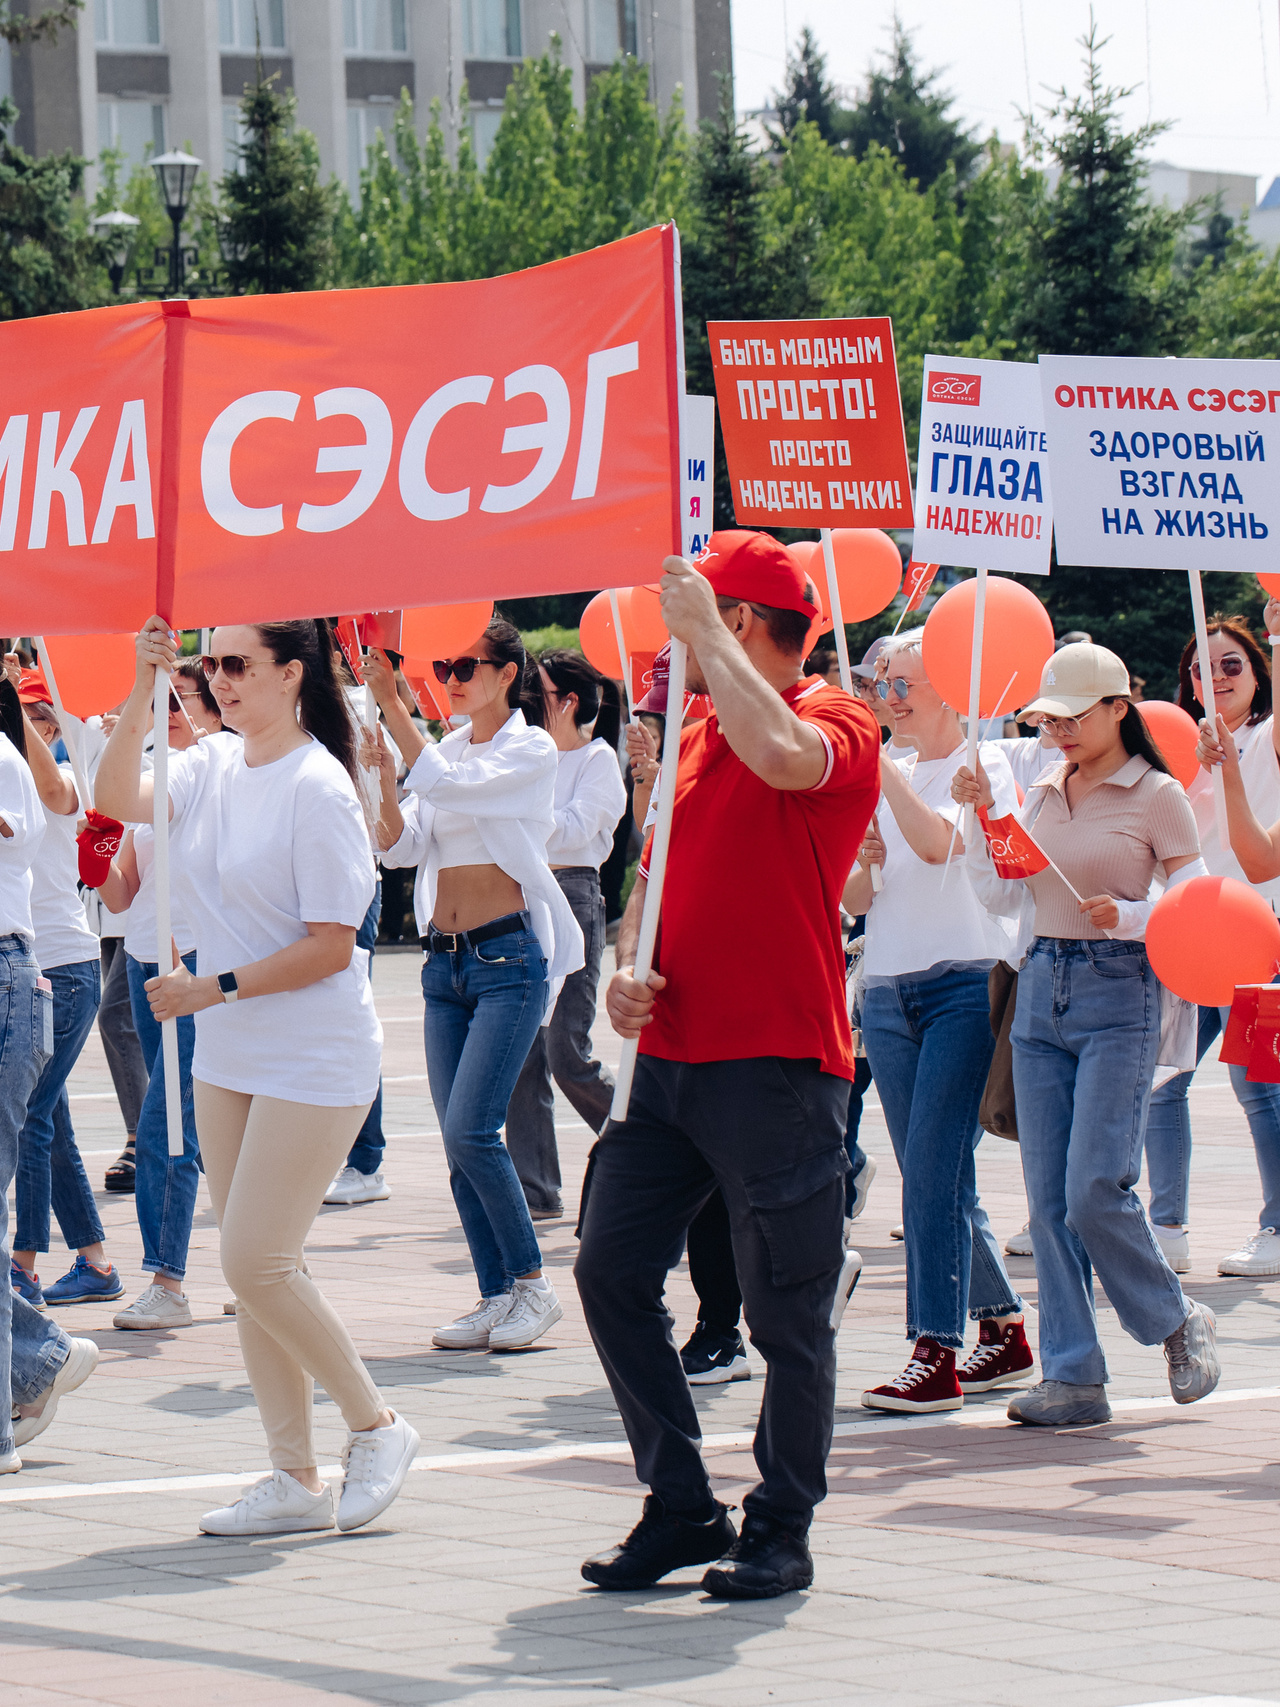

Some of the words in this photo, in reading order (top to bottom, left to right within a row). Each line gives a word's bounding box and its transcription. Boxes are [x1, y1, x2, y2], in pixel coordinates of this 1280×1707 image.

[719, 339, 776, 366] БЫТЬ
[780, 336, 883, 368] МОДНЫМ
[736, 378, 877, 420] ПРОСТО!
[1054, 384, 1180, 411] ОПТИКА
[1187, 387, 1280, 413] СЭСЭГ
[200, 341, 639, 536] СЭСЭГ
[769, 440, 852, 466] ПРОСТО
[931, 421, 1048, 453] ЗАЩИЩАЙТЕ
[1088, 429, 1266, 463] ЗДОРОВЫЙ
[930, 452, 1043, 503] ГЛАЗА
[1119, 469, 1244, 505] ВЗГЛЯД
[739, 479, 823, 512] НАДЕНЬ
[827, 480, 903, 510] ОЧКИ!
[926, 504, 1042, 540] НАДЕЖНО!
[1101, 507, 1144, 535] НА
[1154, 508, 1269, 540] ЖИЗНЬ
